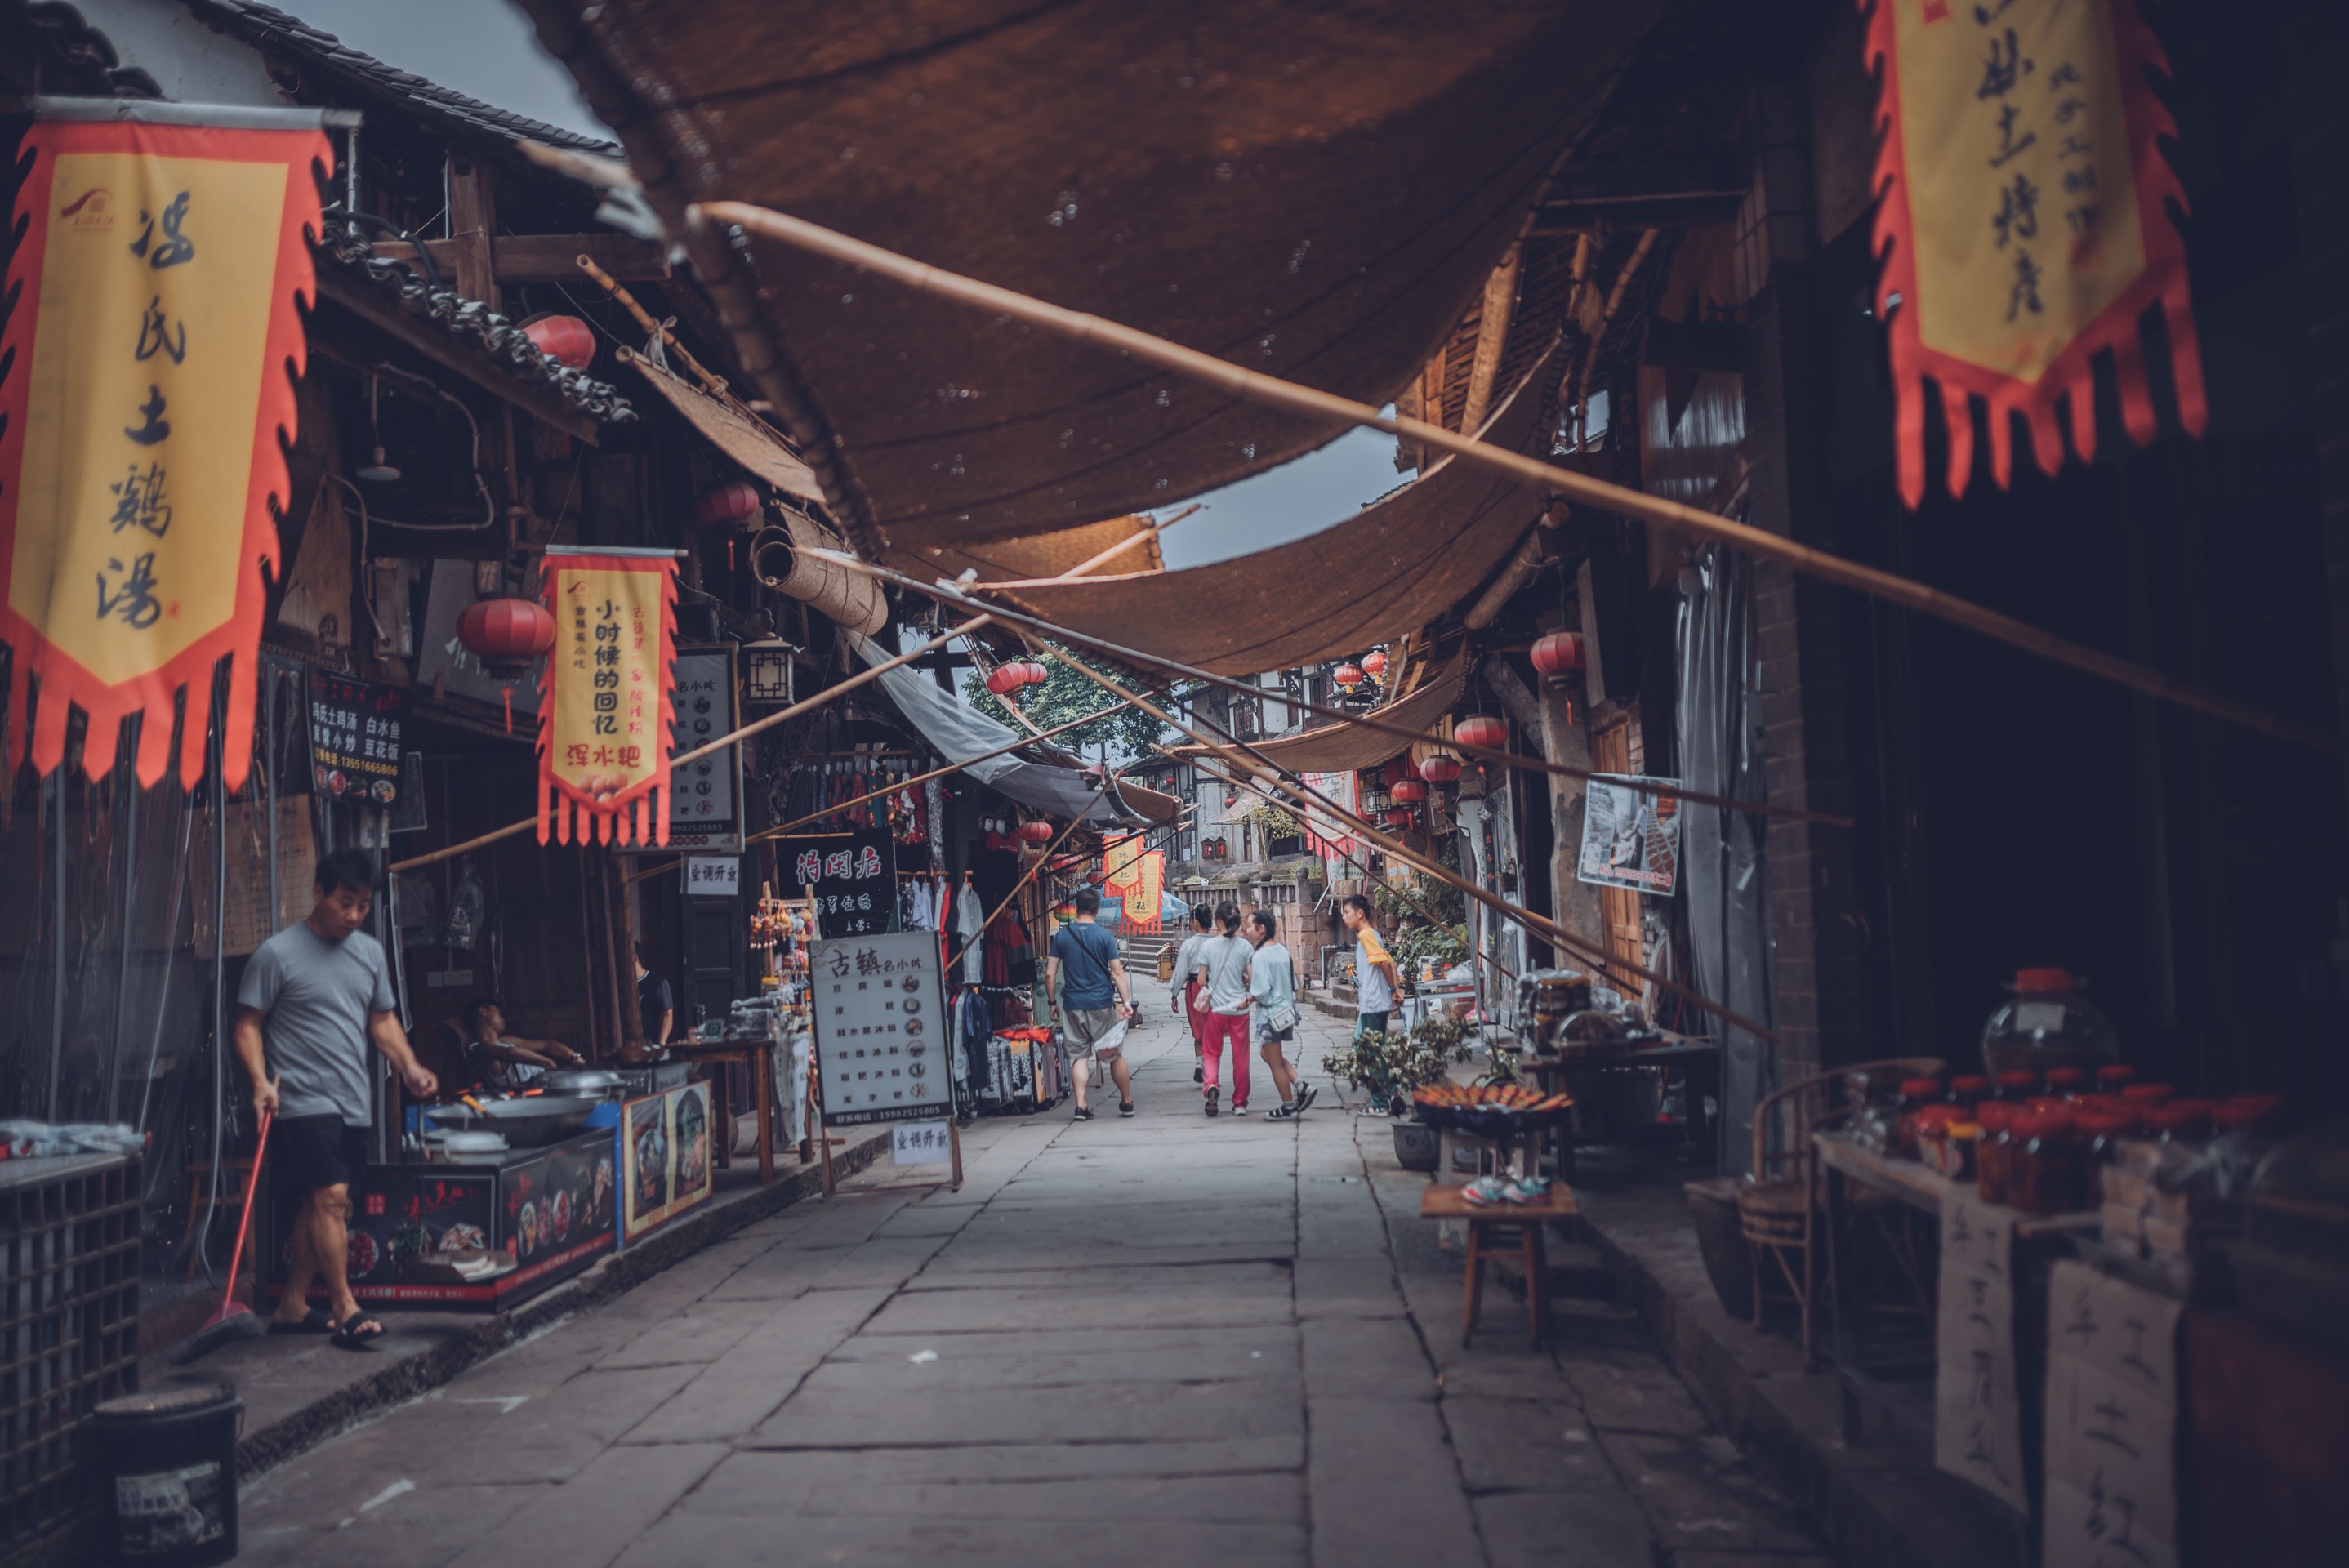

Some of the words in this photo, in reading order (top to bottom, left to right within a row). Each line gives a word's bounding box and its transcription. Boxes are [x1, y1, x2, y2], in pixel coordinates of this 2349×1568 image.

[593, 599, 623, 735] 小时候的回忆
[312, 702, 358, 731] 冯氏土鸡汤
[366, 716, 400, 739] 白水鱼
[313, 724, 356, 752] 家常小炒
[363, 738, 399, 761] 豆花饭
[567, 743, 640, 768] 浑水粑
[691, 863, 738, 882] 空调开放
[839, 1045, 898, 1060] 玫瑰冰粉
[897, 1129, 948, 1150] 空调开放
